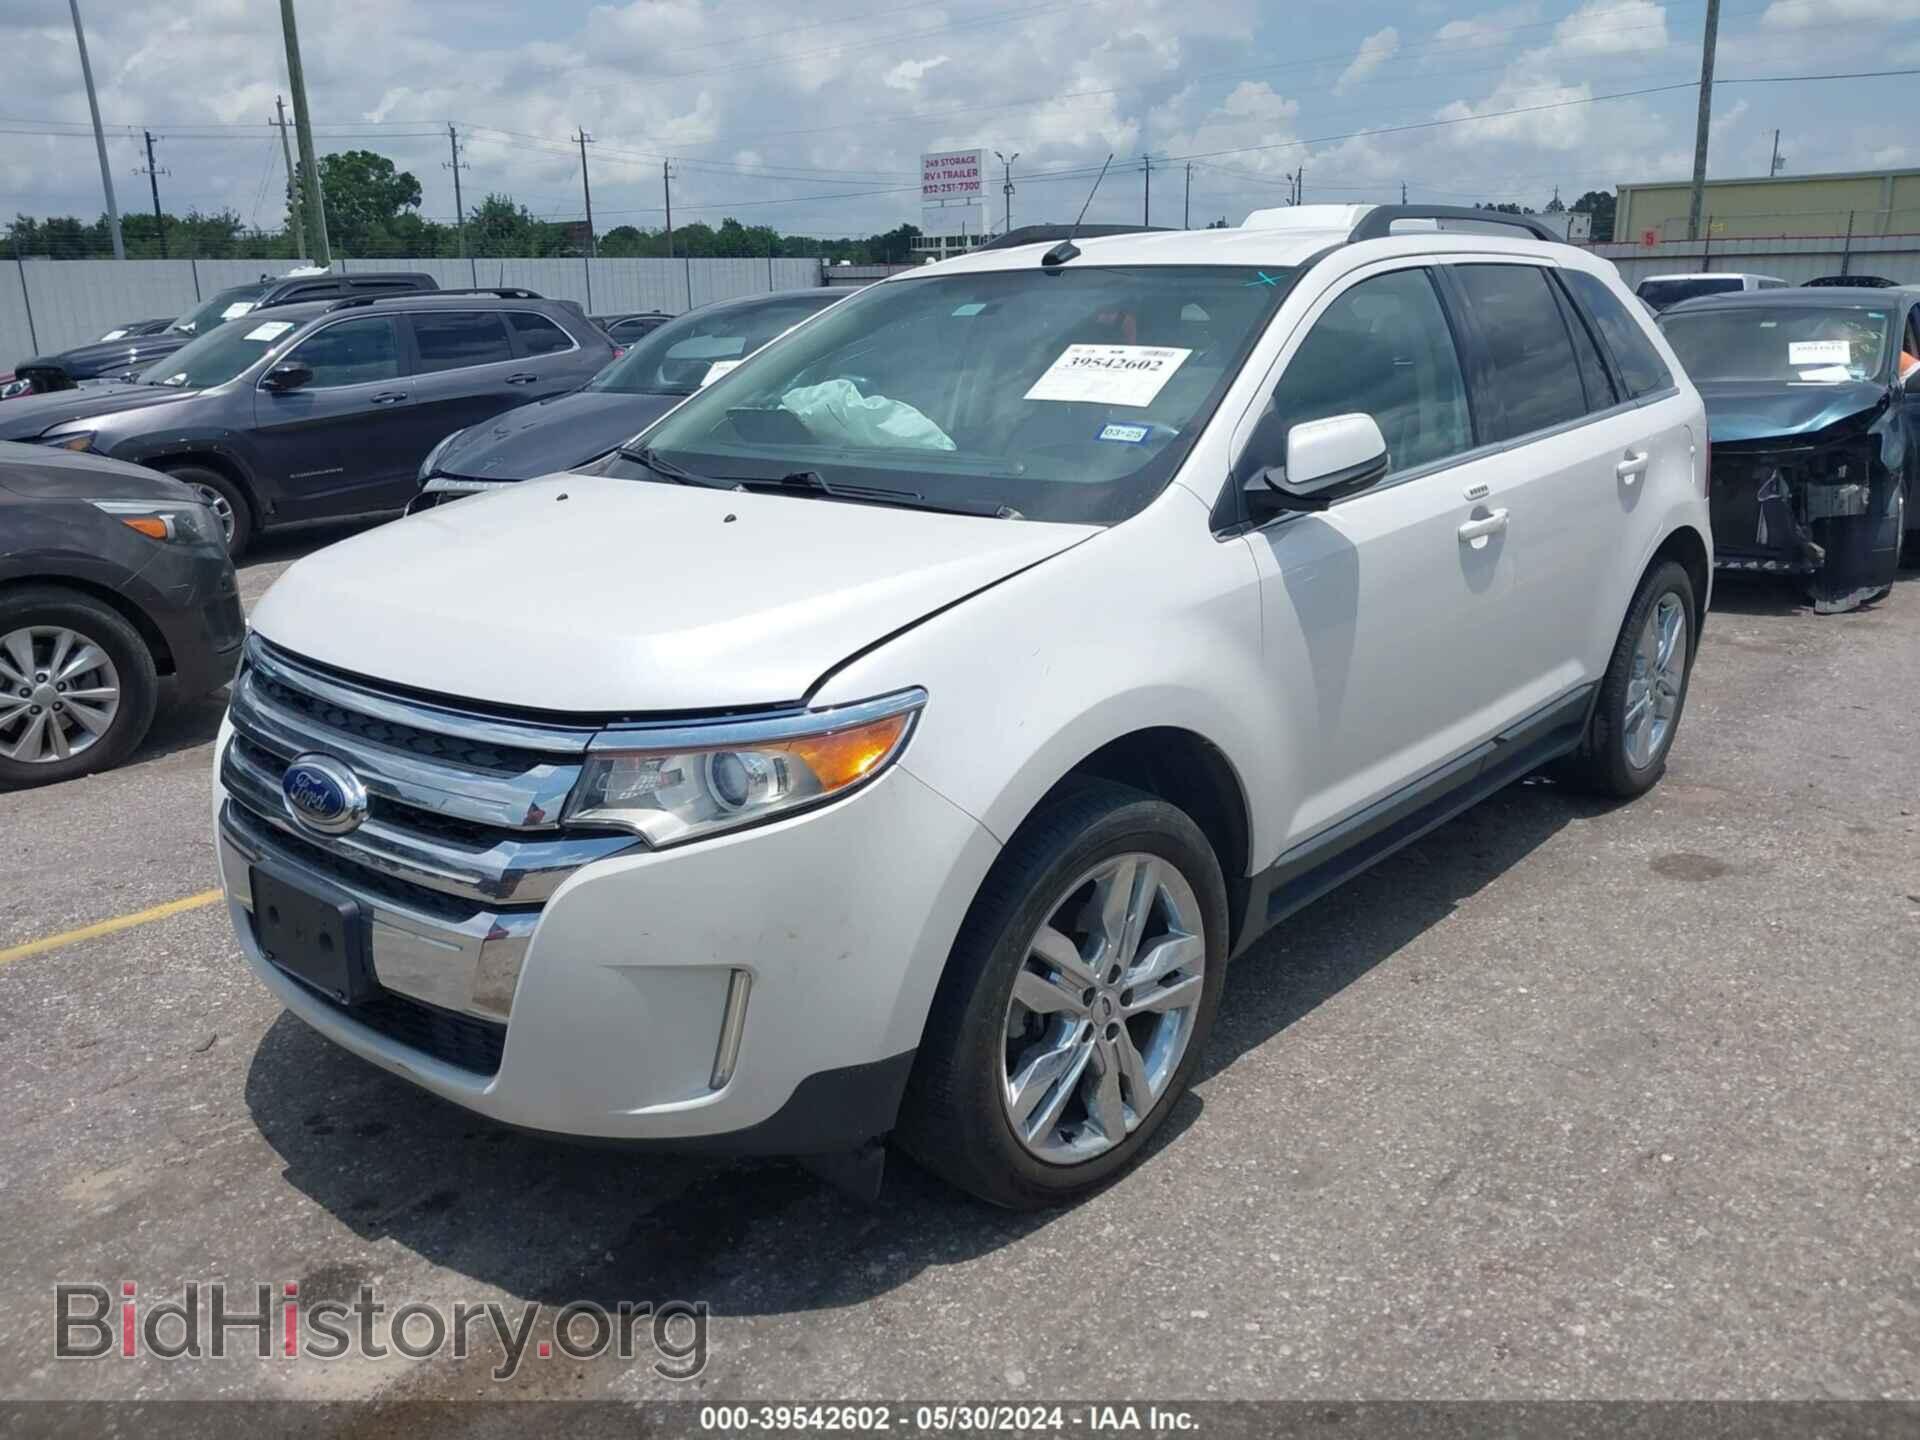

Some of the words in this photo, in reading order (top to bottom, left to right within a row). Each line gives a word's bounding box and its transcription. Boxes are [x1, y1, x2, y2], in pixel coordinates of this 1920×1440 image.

[925, 159, 939, 169] 249
[940, 156, 977, 167] STORAGE
[924, 171, 936, 181] RV
[942, 168, 979, 180] TRAILER
[923, 181, 980, 194] 832-251-7300
[1066, 356, 1164, 371] 39542602
[1104, 427, 1142, 440] 03-25
[290, 771, 330, 811] Ford
